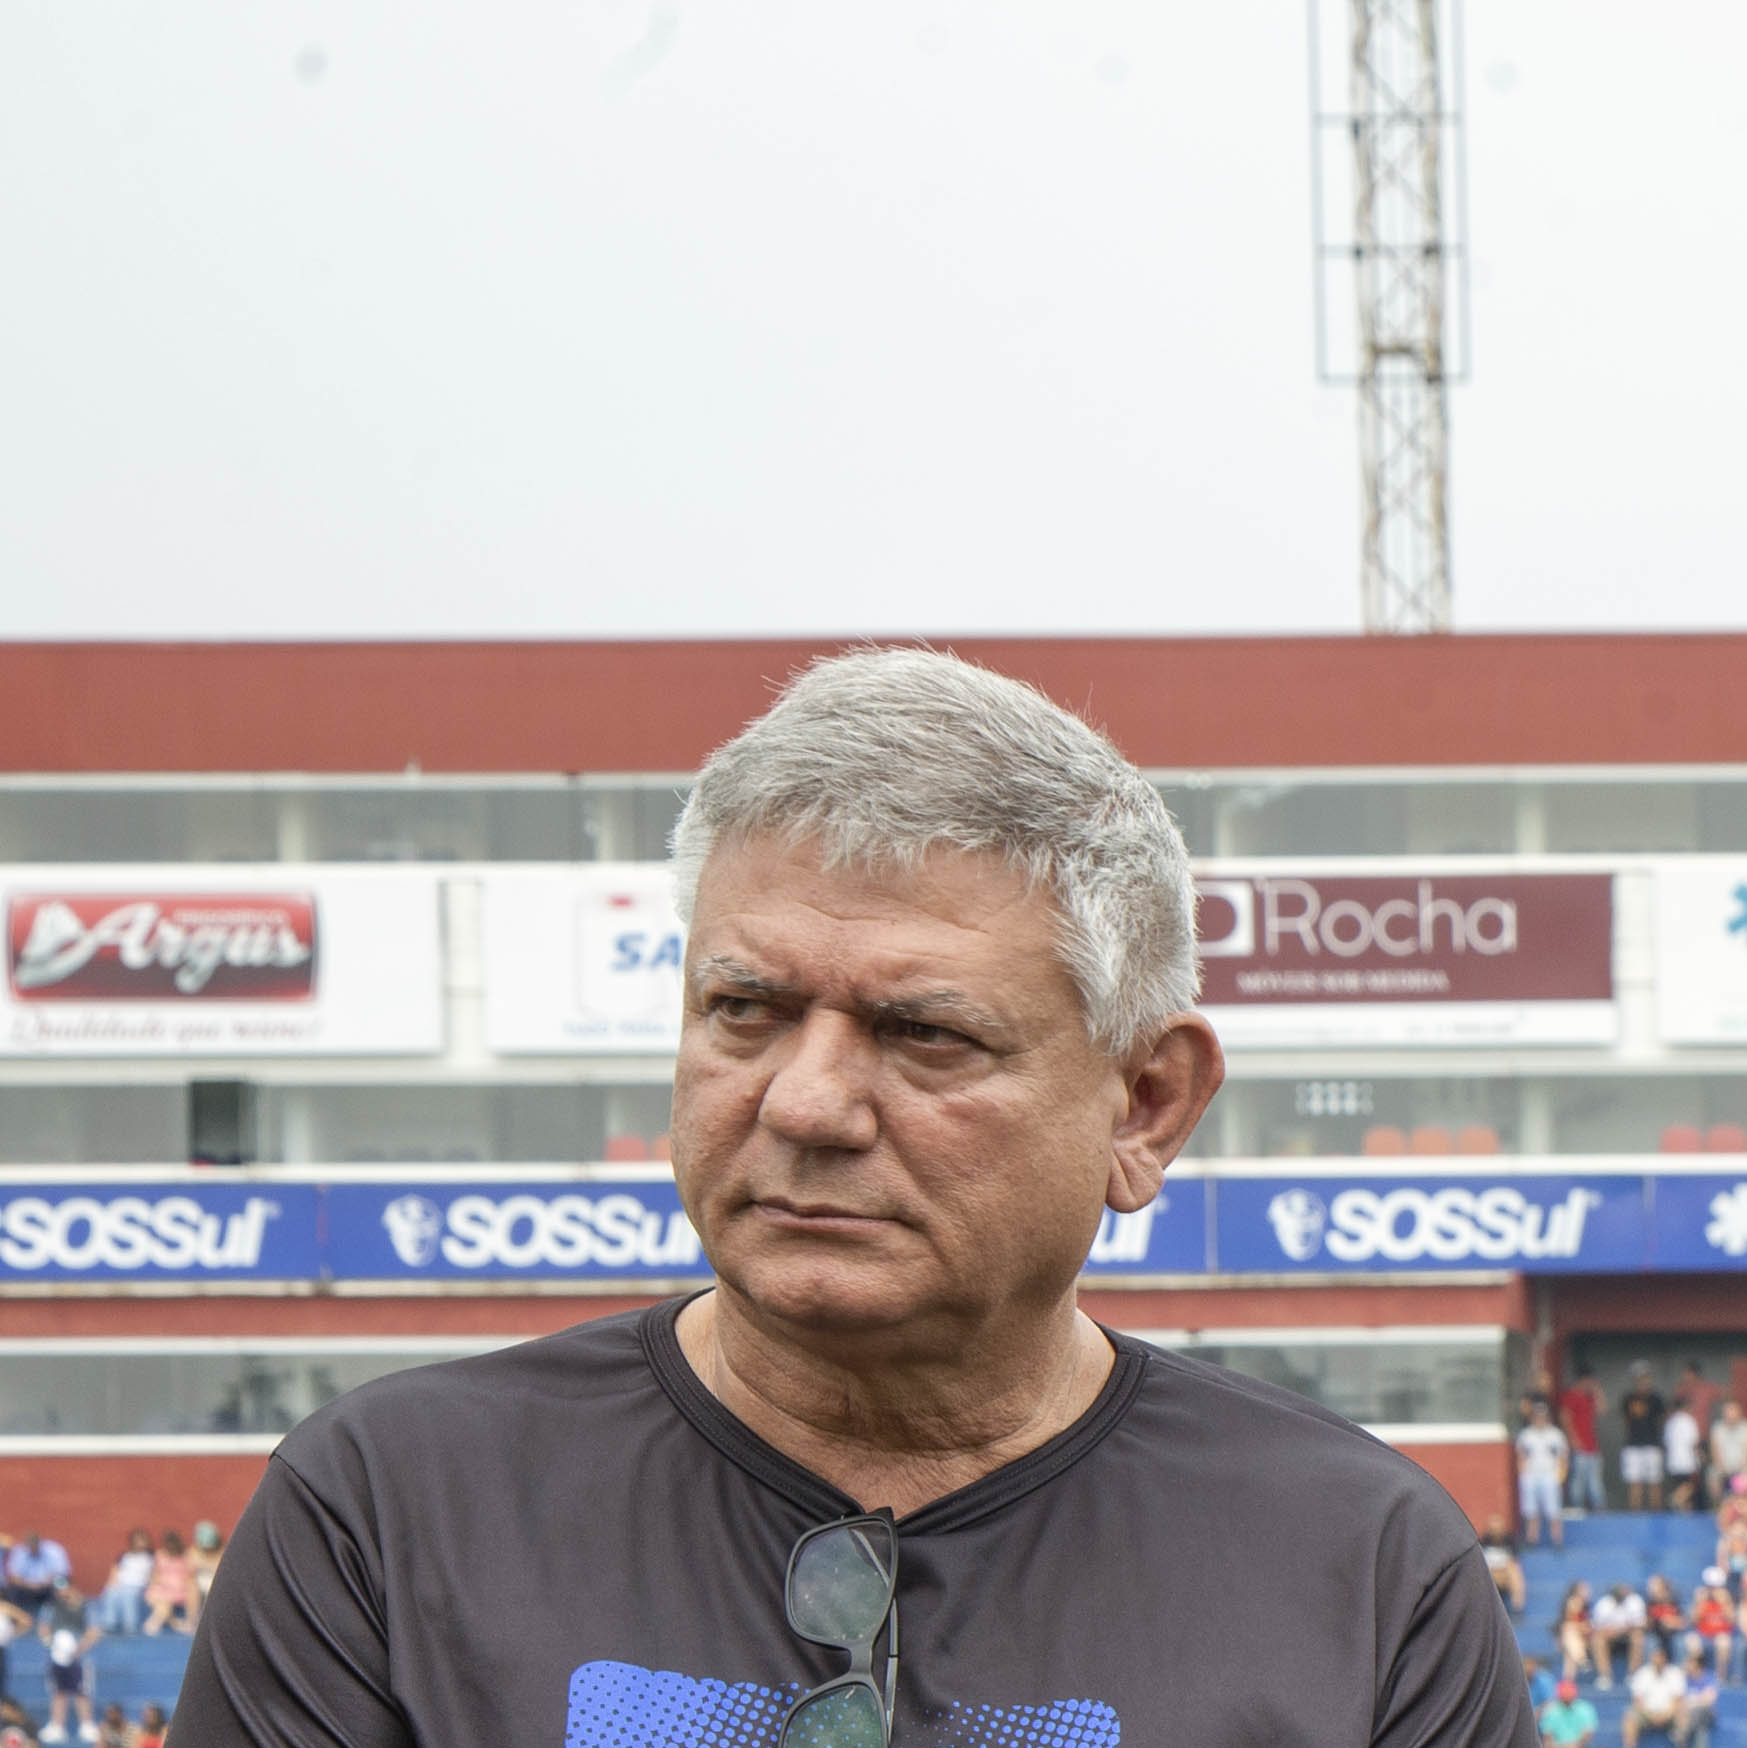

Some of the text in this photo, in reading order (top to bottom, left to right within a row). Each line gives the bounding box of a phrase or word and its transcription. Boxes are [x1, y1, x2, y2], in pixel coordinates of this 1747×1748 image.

[20, 899, 312, 994] Argus
[1262, 877, 1519, 958] Rocha
[3, 1194, 270, 1271] SOSSul
[1325, 1185, 1590, 1262] SOSSul
